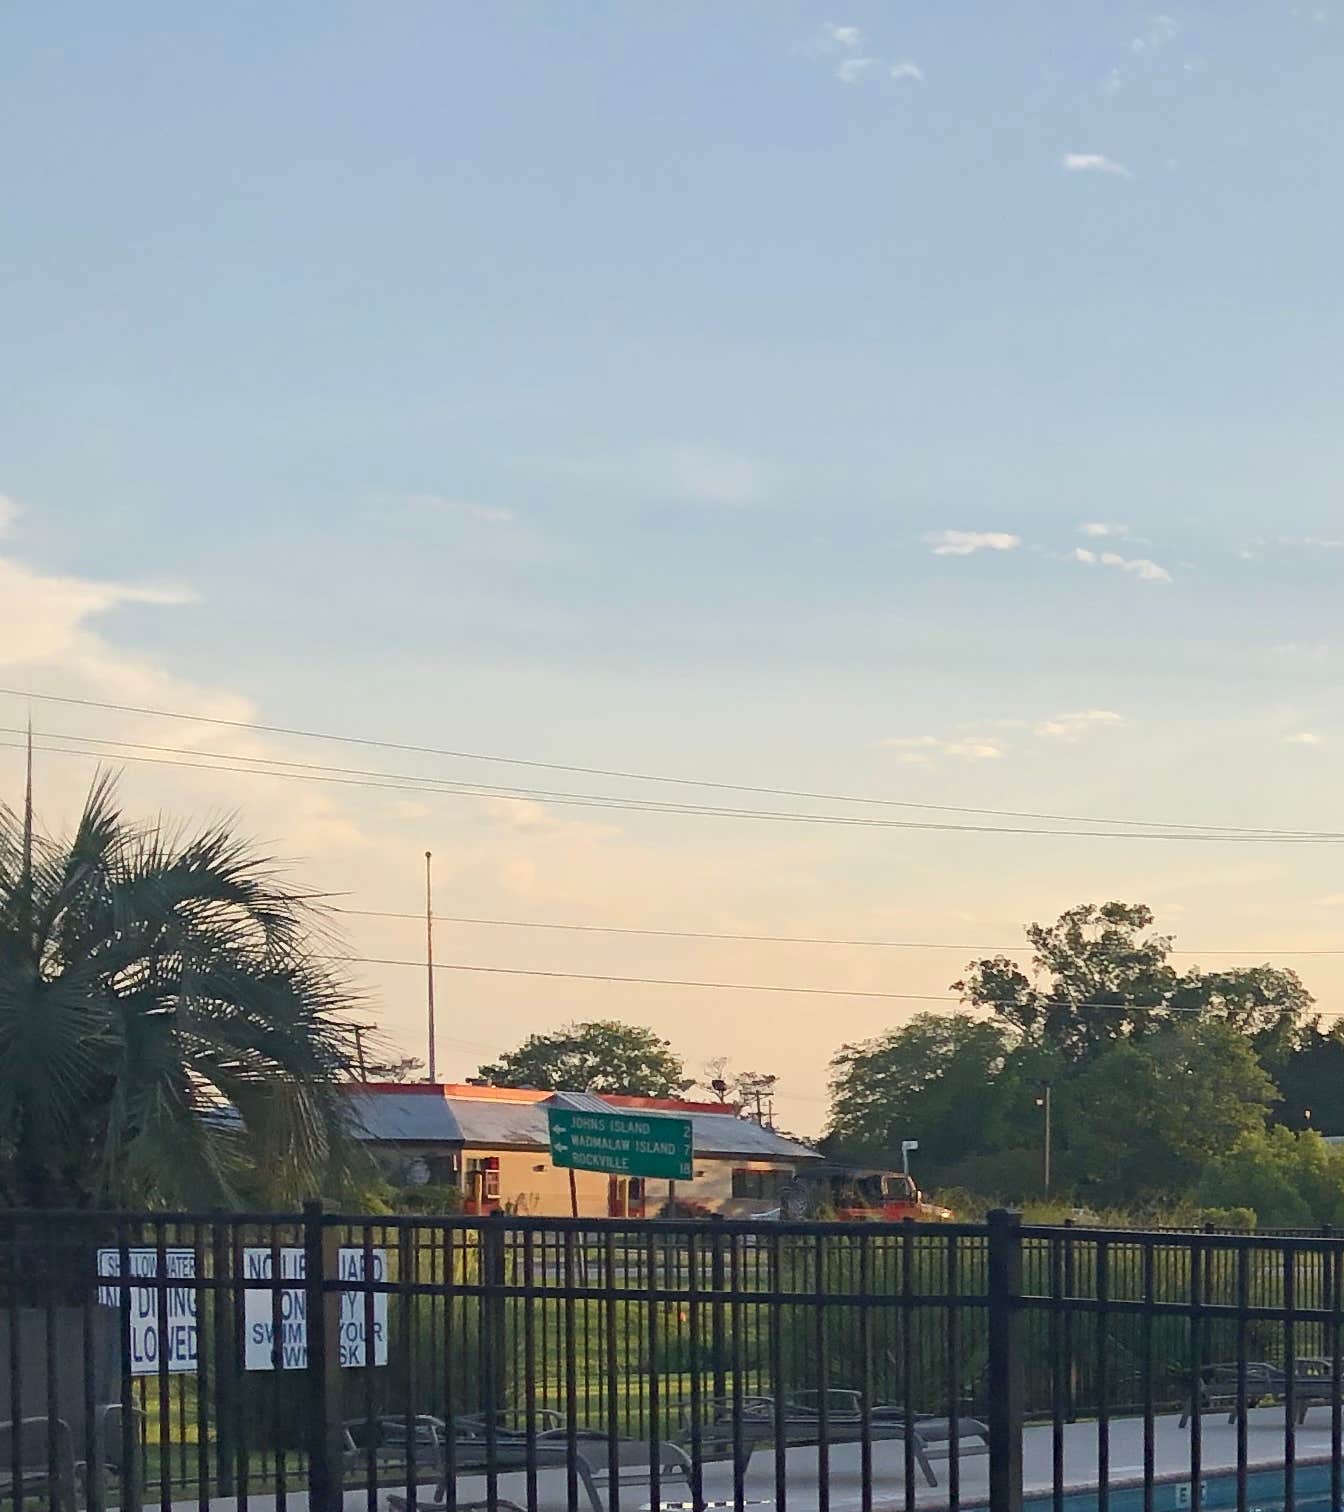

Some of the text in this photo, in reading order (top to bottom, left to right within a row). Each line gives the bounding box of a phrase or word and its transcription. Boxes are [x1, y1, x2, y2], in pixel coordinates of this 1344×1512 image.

[570, 1116, 690, 1138] JOHNS ISLAND 2
[571, 1135, 690, 1155] WADMALAW ISLAND 7
[572, 1152, 629, 1170] ROCKVILLE
